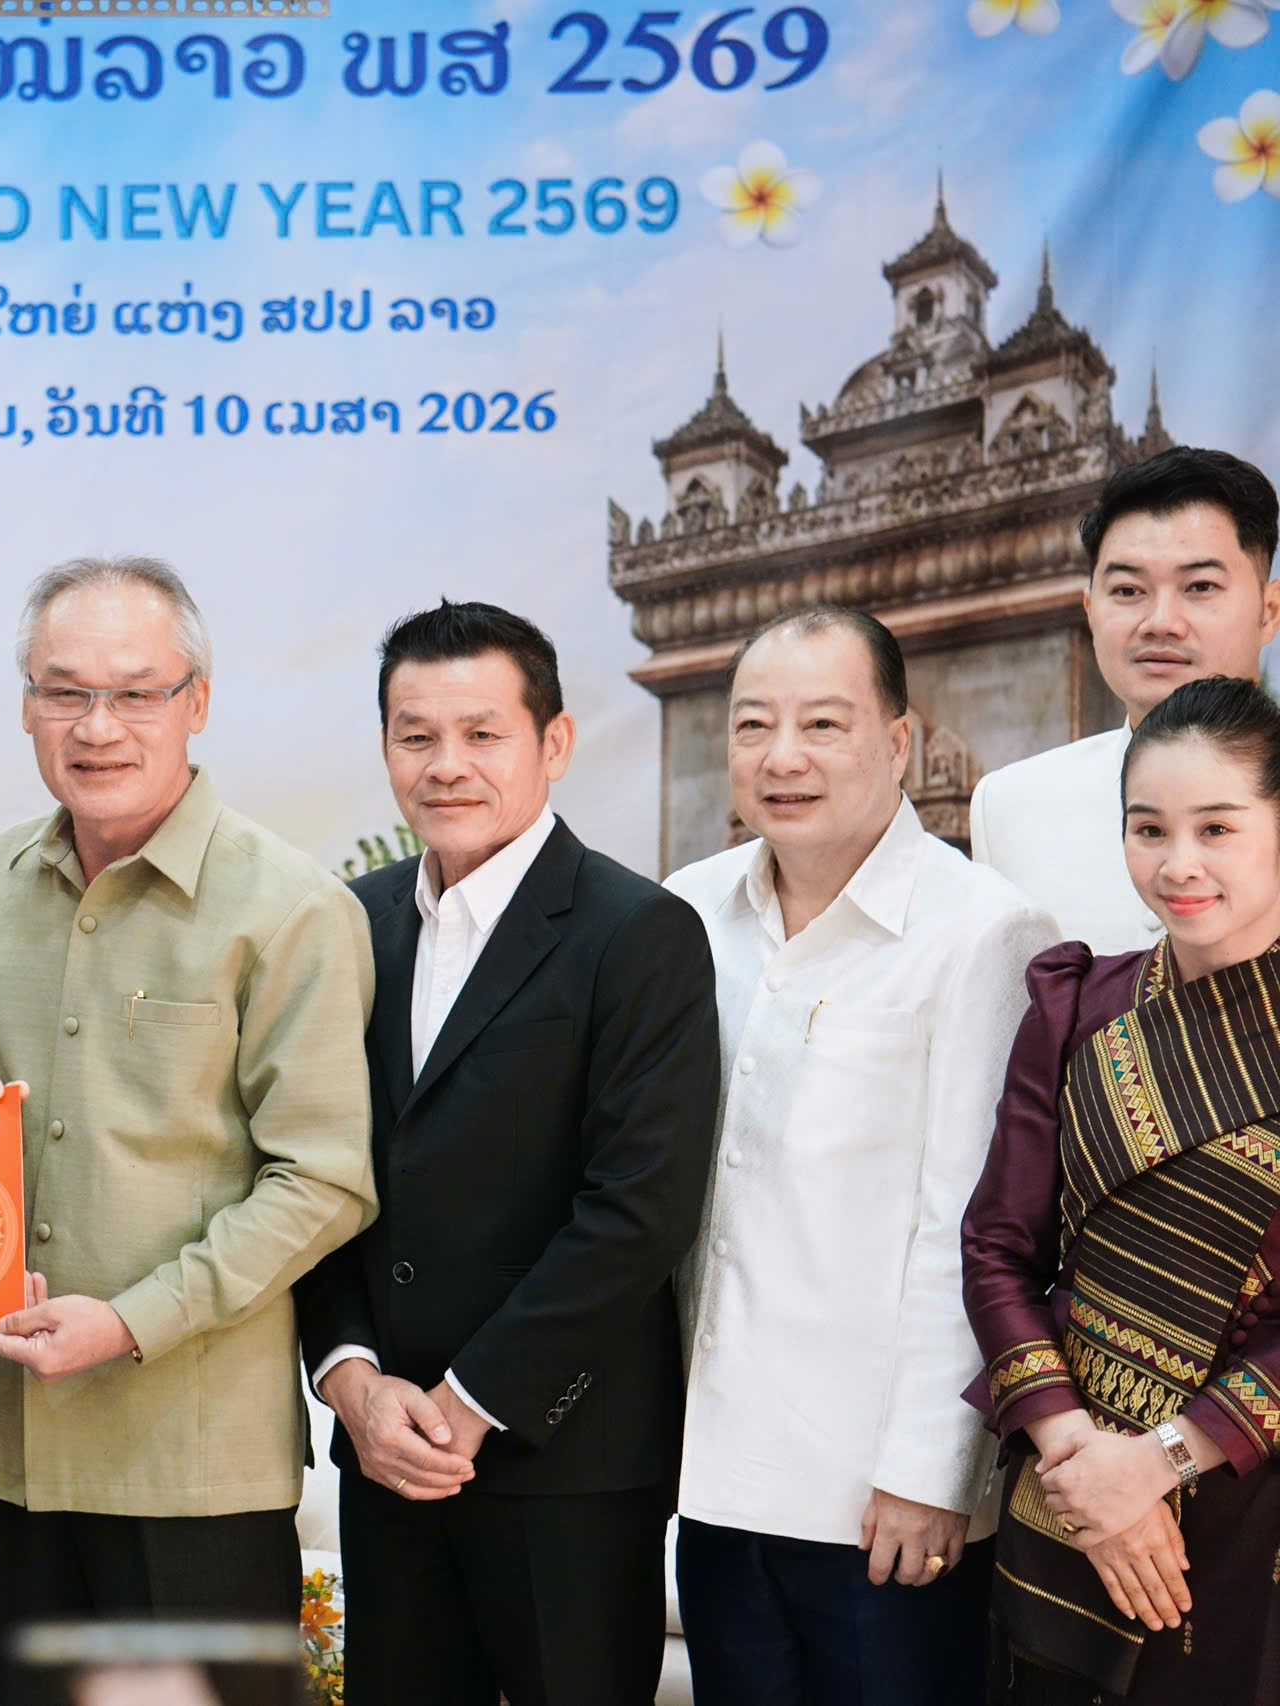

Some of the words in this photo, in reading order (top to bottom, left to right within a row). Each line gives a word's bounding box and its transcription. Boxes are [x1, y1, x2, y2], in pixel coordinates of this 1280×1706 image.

[341, 20, 510, 98] ພສ
[547, 6, 830, 95] 2569
[58, 182, 237, 241] NEW
[259, 179, 465, 239] YEAR
[487, 176, 681, 237] 2569
[261, 289, 371, 333] ສປປ
[389, 296, 497, 332] ລາວ
[184, 395, 249, 436] 10
[264, 396, 401, 436] ເມສາ
[418, 391, 557, 433] 2026
